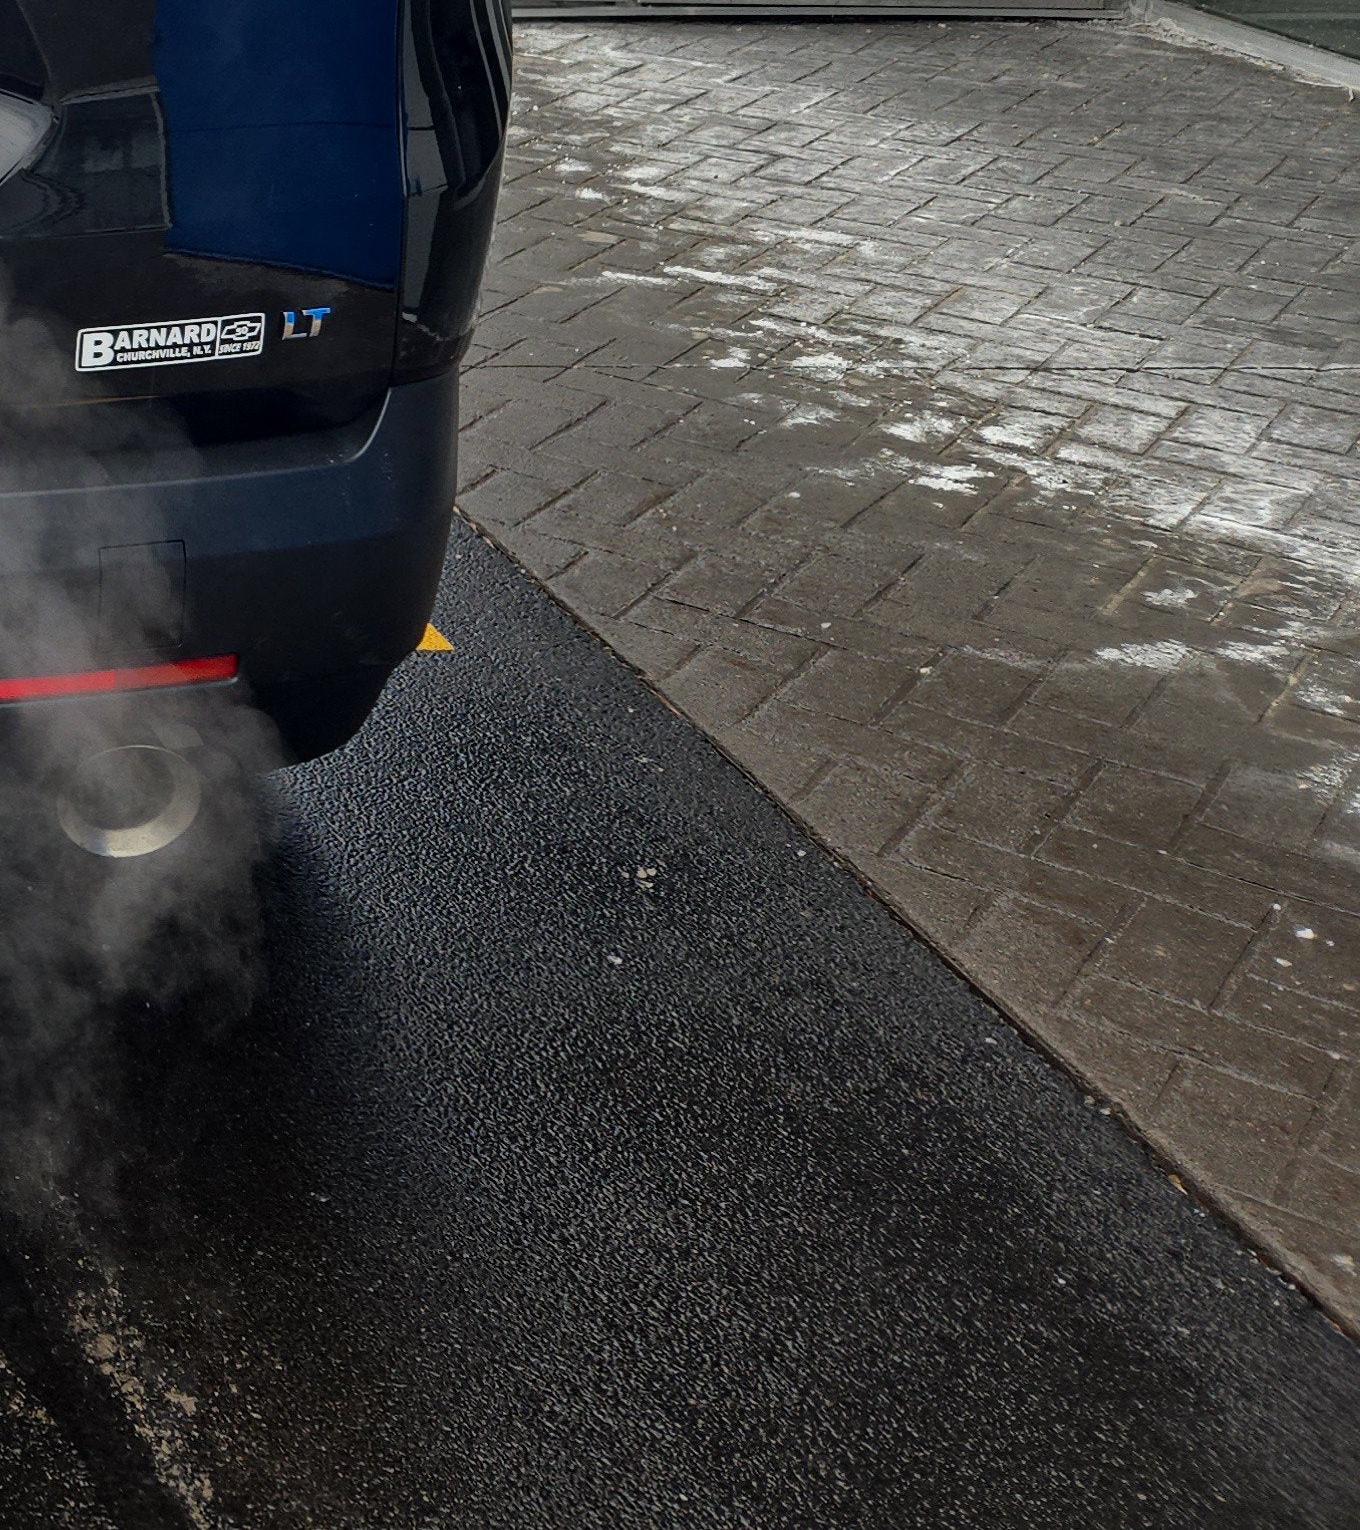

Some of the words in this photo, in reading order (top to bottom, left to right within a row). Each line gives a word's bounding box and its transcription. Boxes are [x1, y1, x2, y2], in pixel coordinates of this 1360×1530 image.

[281, 307, 333, 341] LT
[81, 323, 217, 367] BARNARD
[116, 349, 191, 363] CHURCHVILLE,
[192, 344, 212, 356] N.Y.
[218, 343, 242, 354] SINCE
